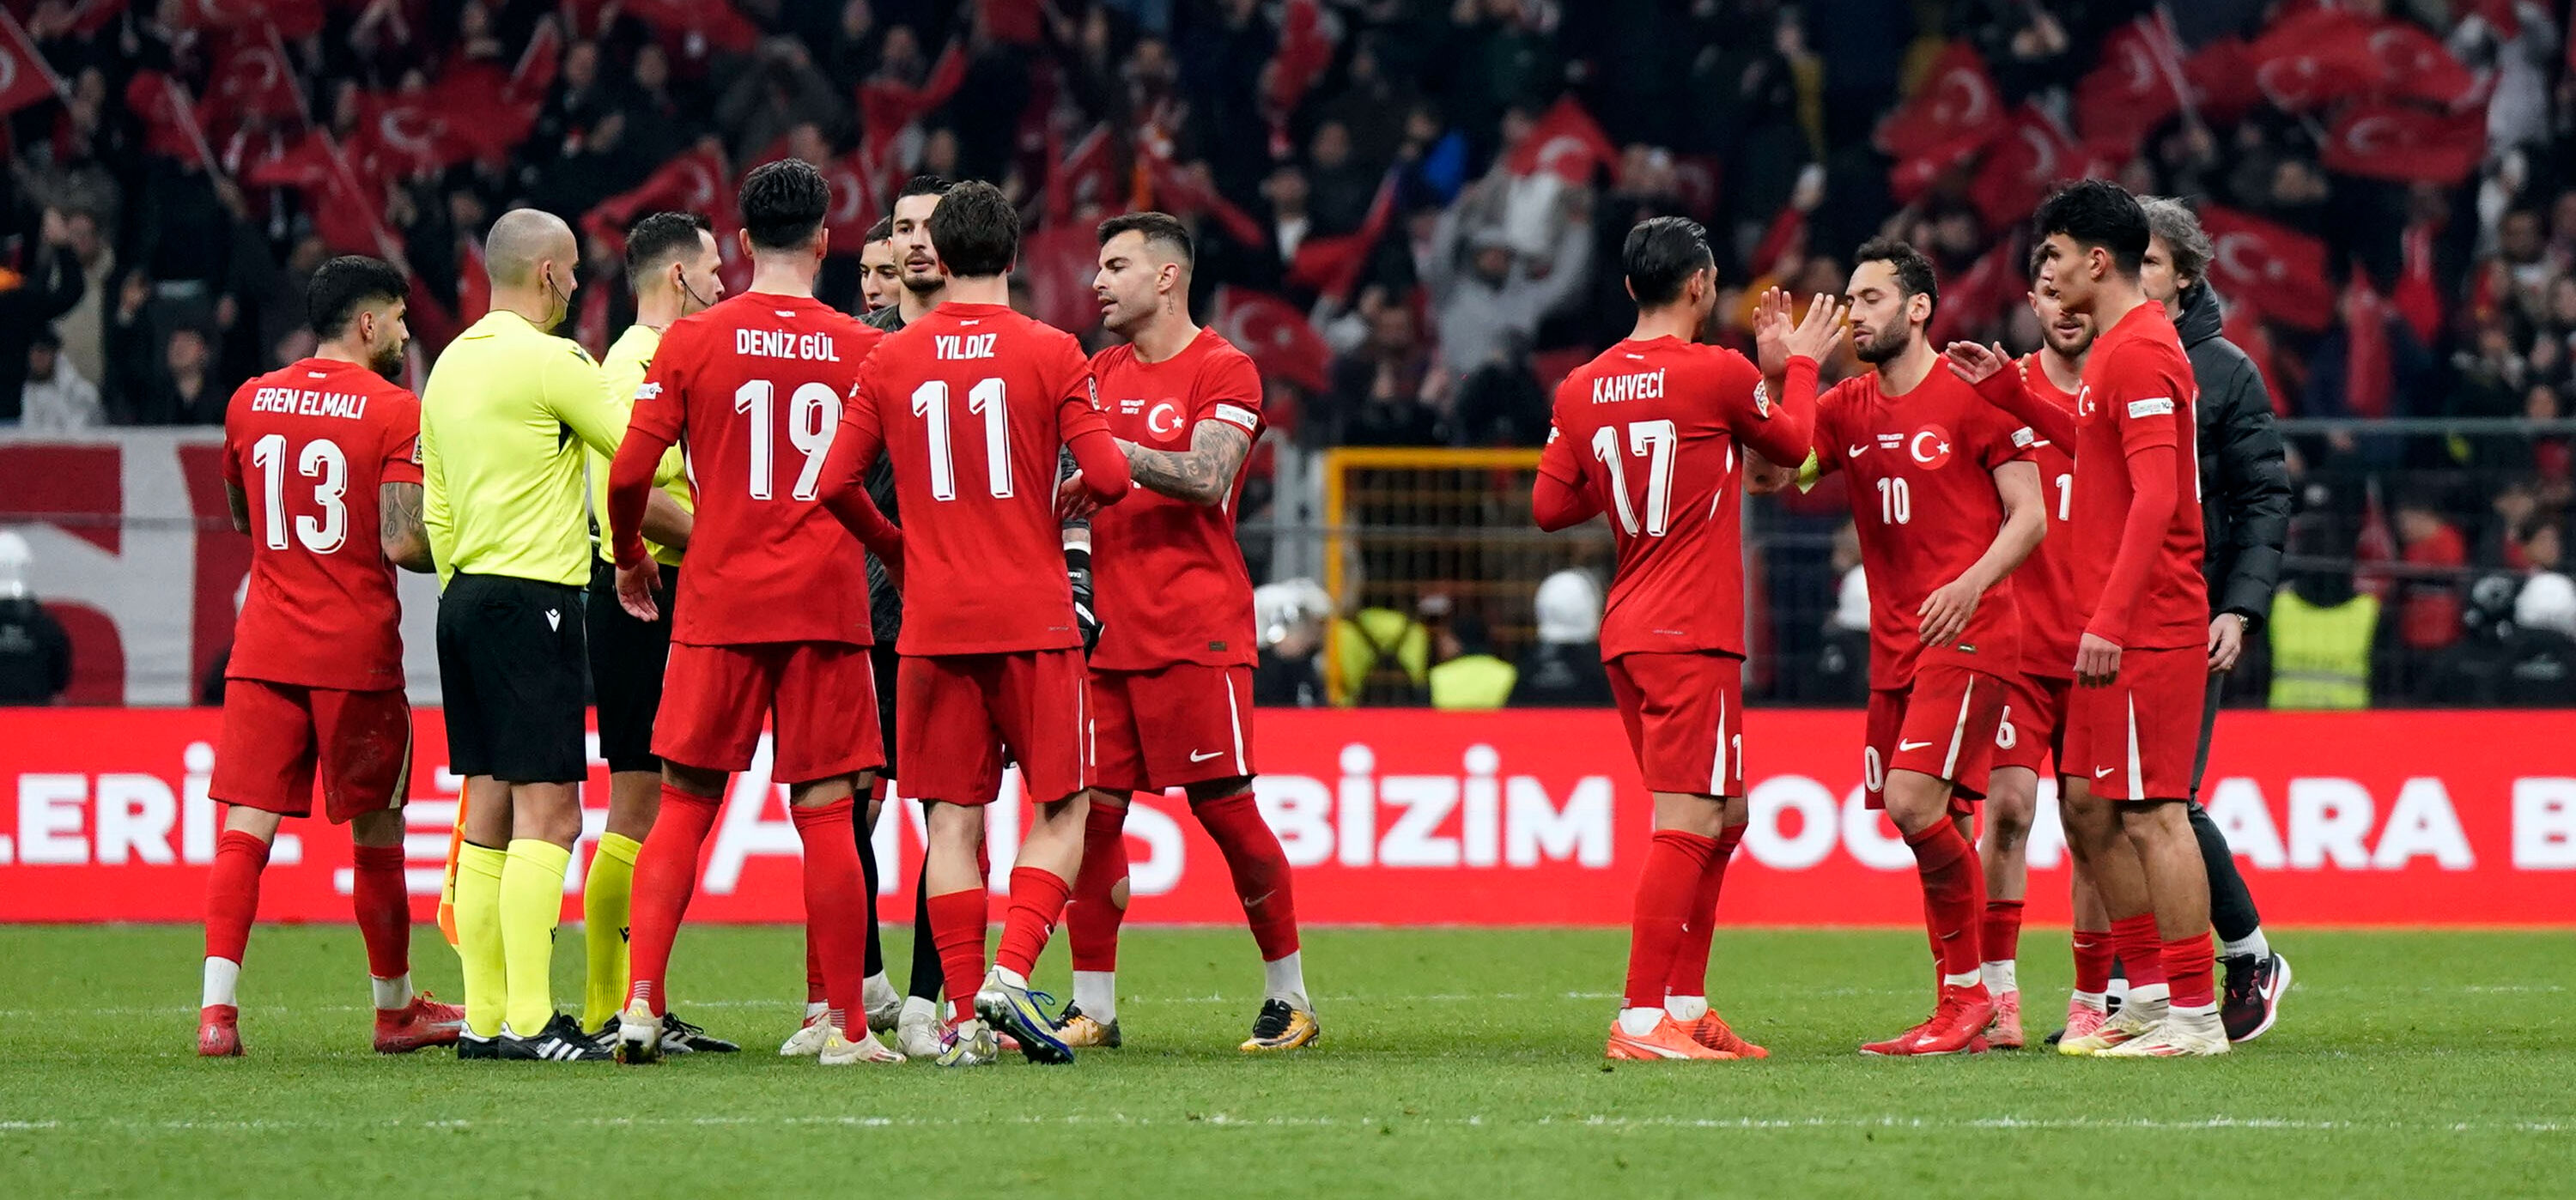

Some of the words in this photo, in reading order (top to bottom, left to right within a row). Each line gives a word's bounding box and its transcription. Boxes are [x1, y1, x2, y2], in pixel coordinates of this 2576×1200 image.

[736, 328, 797, 360] DENİZ
[799, 331, 841, 362] GÜL
[935, 333, 997, 360] YILDIZ
[252, 387, 300, 414] EREN
[299, 390, 368, 420] ELMALI
[1592, 367, 1666, 404] KAHVECİ
[735, 379, 843, 501] 19
[912, 378, 1014, 501] 11
[253, 433, 348, 555] 13
[1591, 419, 1677, 537] 17
[1877, 476, 1910, 524] 10
[1996, 706, 2016, 749] 6
[1249, 742, 1614, 867] BİZİM
